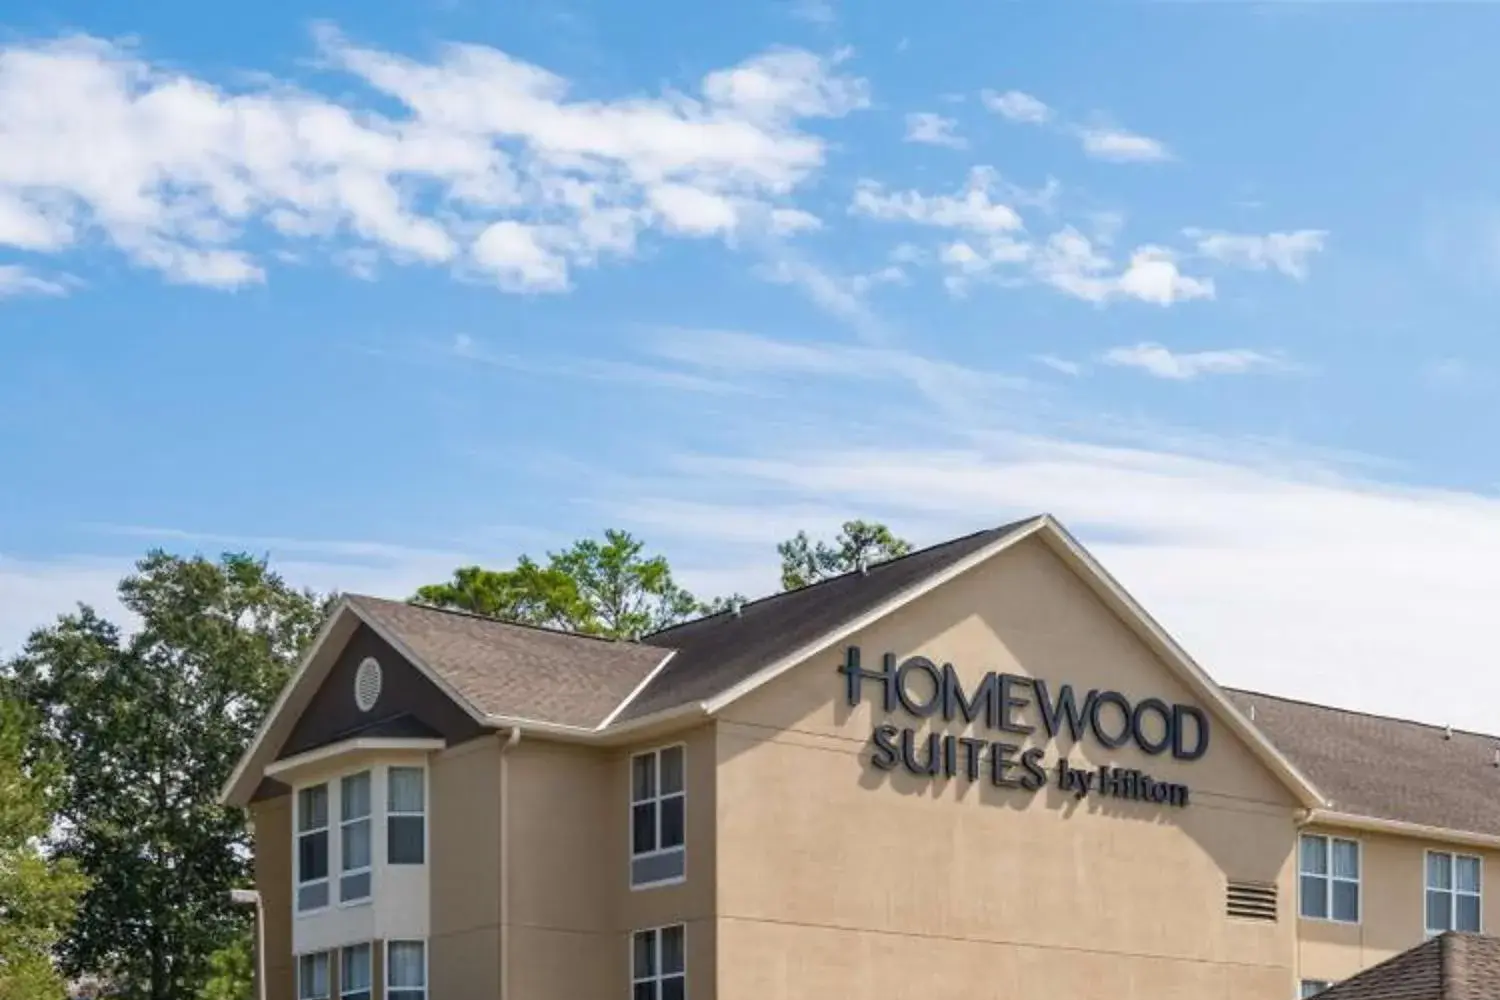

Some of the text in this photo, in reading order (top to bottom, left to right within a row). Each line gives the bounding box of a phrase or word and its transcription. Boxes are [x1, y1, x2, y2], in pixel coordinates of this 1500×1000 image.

[838, 646, 1209, 761] HOMEWOOD
[871, 724, 1190, 808] SUITES by Hilton
